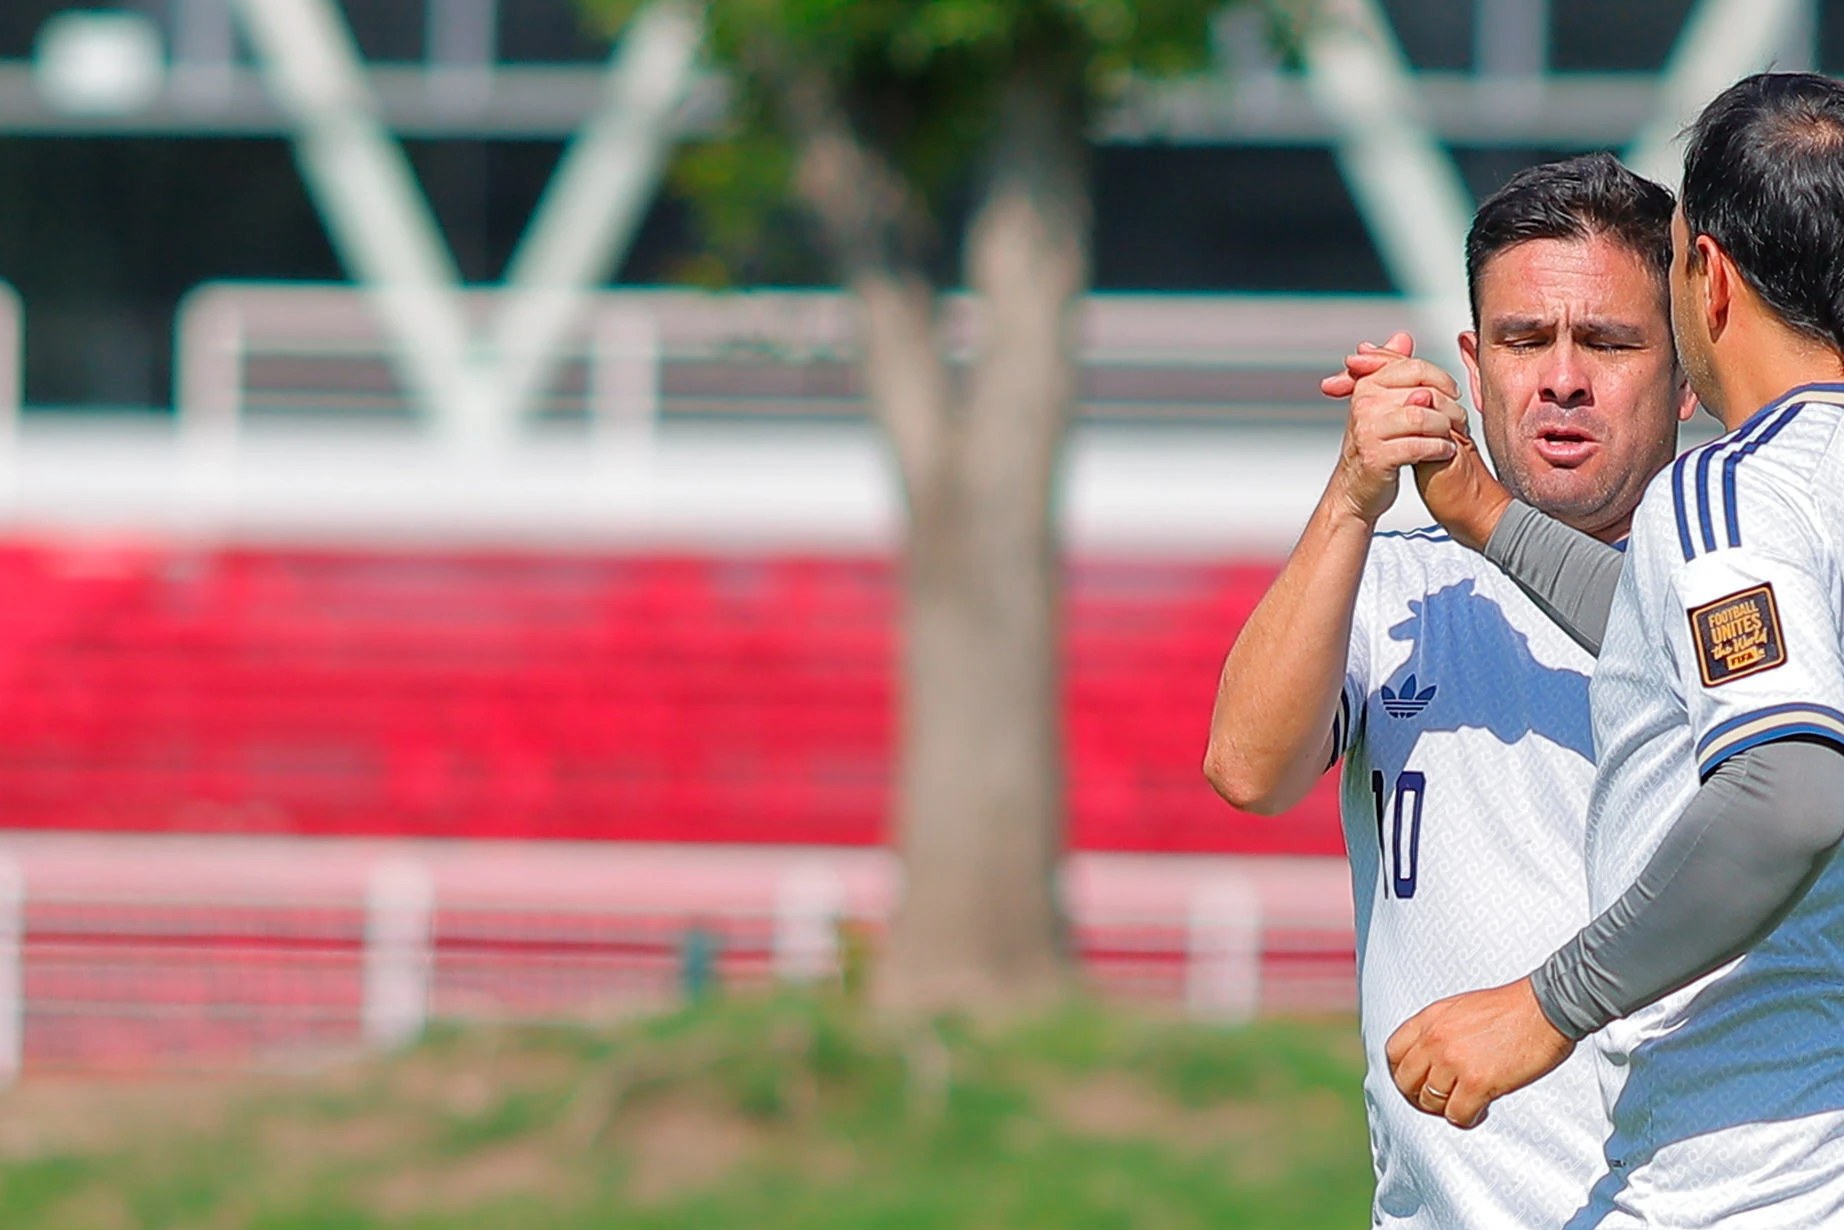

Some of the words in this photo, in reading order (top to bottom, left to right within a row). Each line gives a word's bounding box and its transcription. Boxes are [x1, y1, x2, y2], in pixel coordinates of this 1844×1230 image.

[1707, 599, 1759, 628] FOOTBALL
[1711, 612, 1762, 645] UNITES
[1710, 643, 1733, 661] the
[1733, 627, 1768, 653] World
[1730, 652, 1755, 666] FIFA
[1371, 769, 1427, 899] 10
